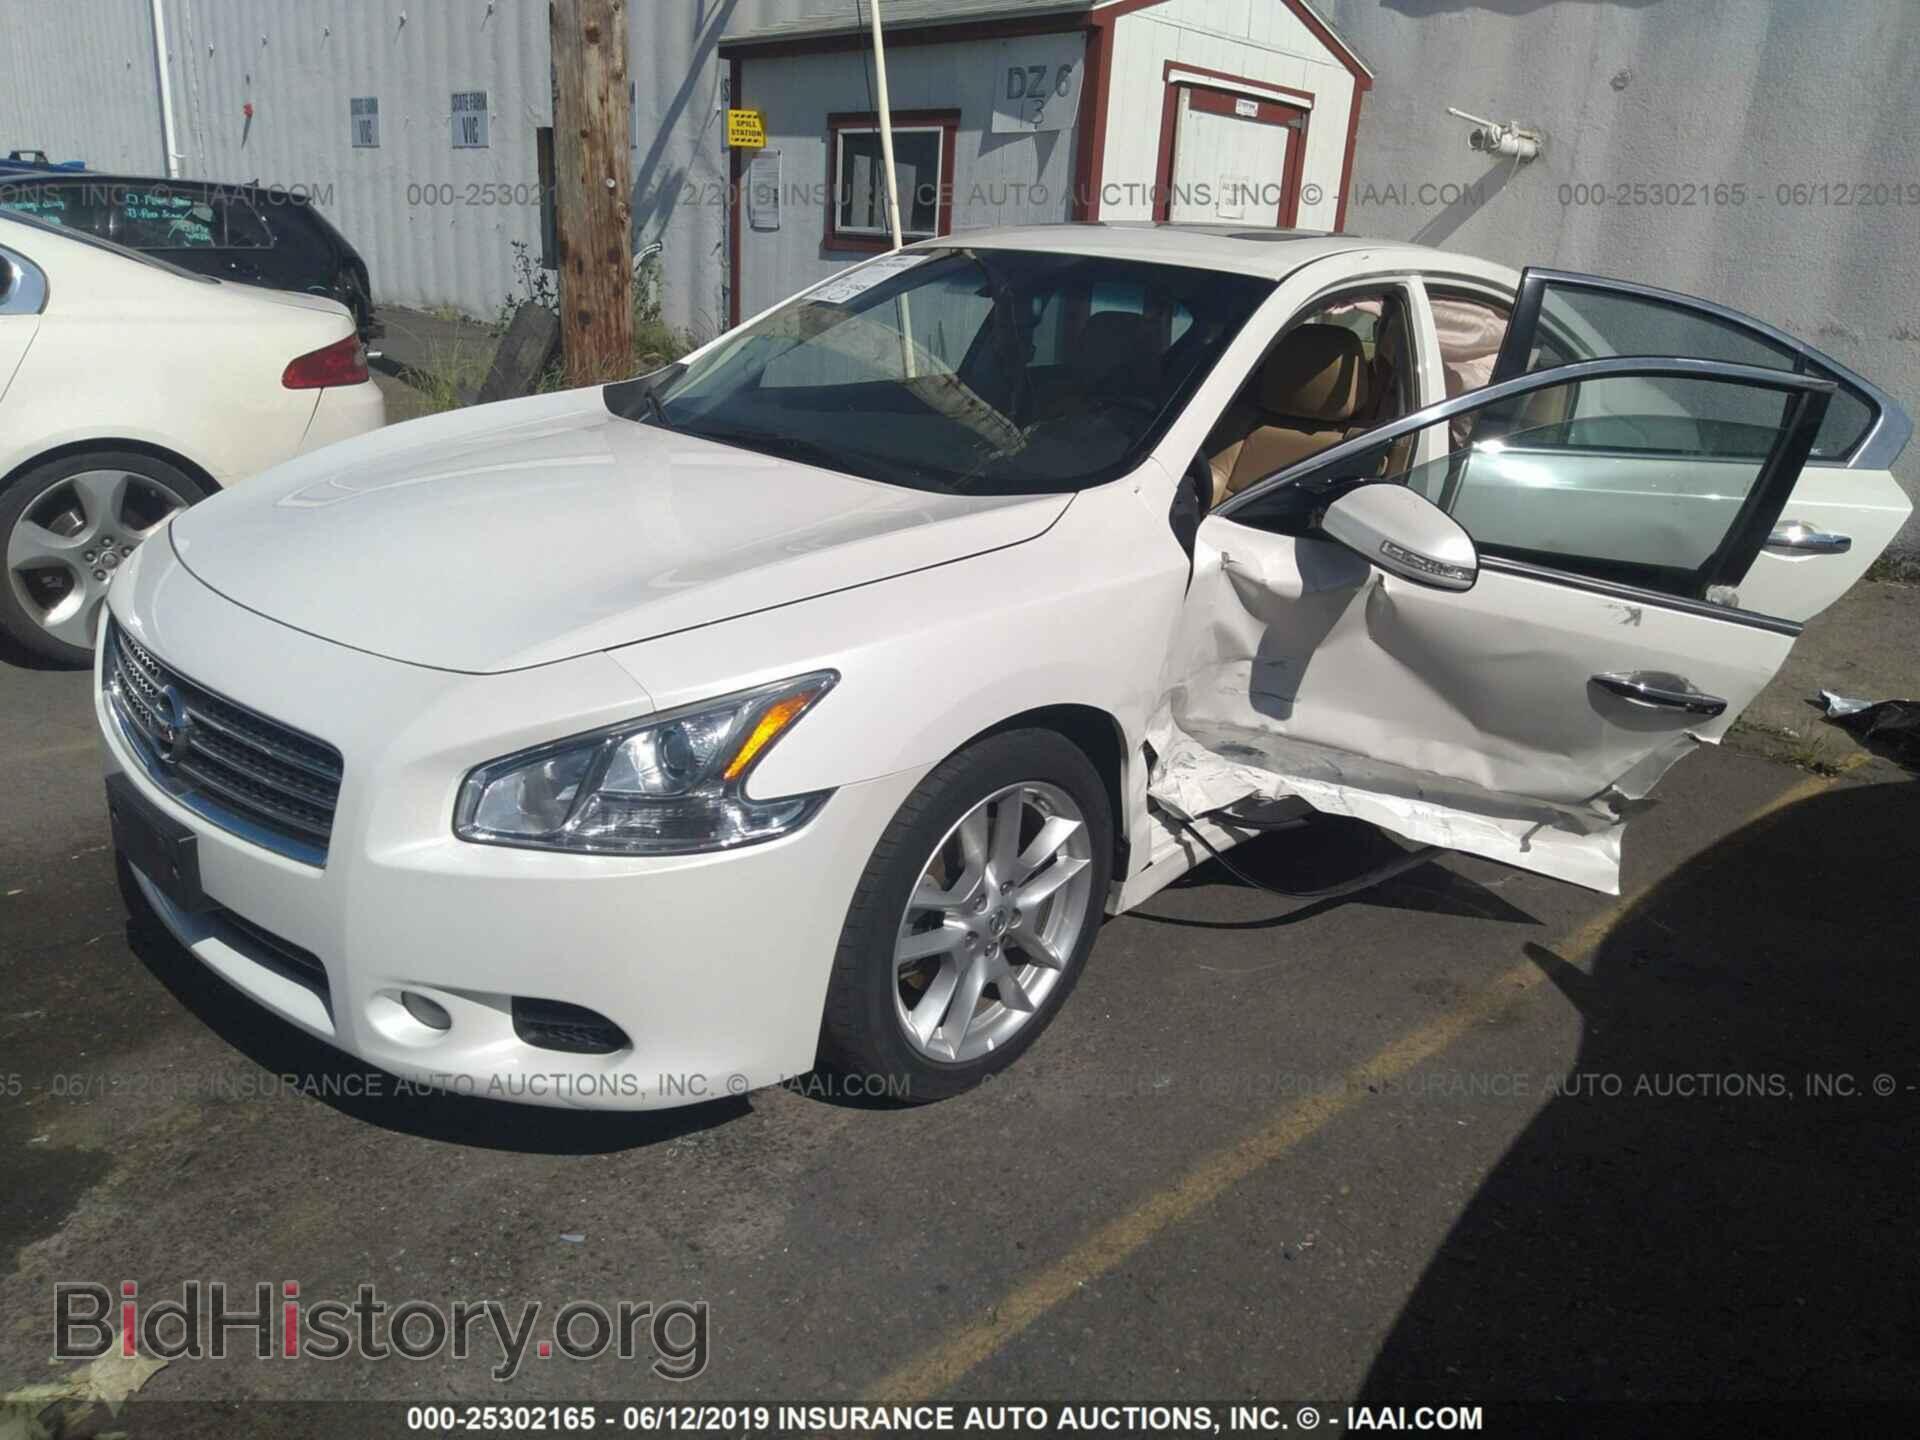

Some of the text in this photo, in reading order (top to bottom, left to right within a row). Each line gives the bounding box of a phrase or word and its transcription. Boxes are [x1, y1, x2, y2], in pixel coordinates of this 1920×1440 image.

[1006, 63, 1072, 99] DZ 6
[462, 117, 478, 144] VIC
[731, 128, 762, 136] STATION
